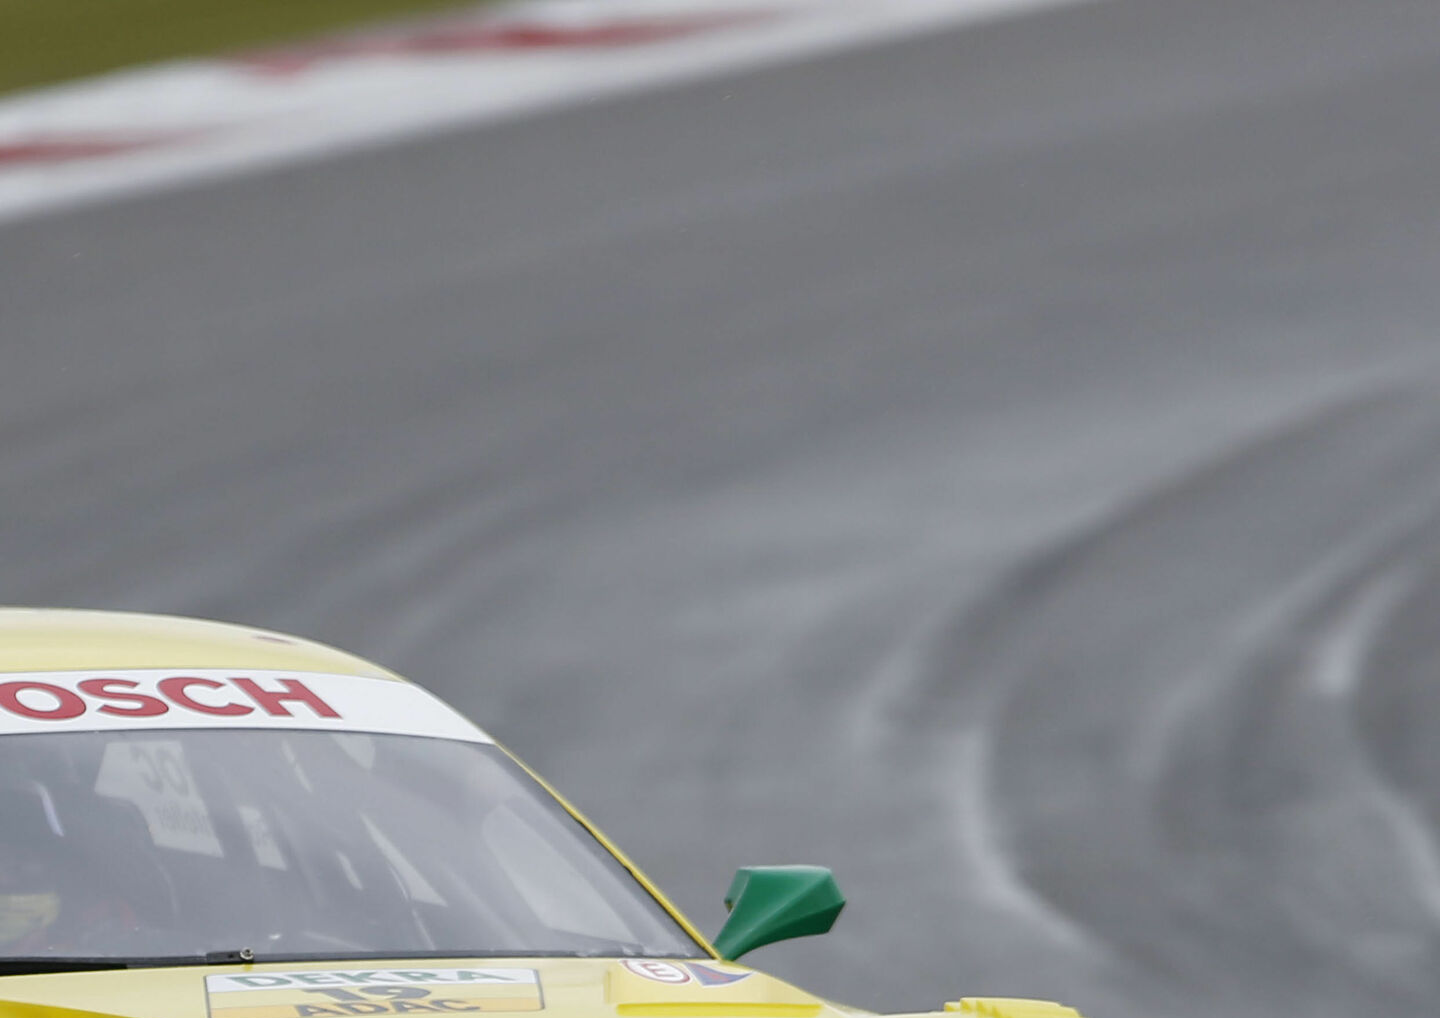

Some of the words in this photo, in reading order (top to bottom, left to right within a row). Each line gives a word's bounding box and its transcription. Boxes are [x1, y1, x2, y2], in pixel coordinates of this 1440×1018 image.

[228, 969, 516, 987] DEKRA
[302, 986, 431, 1001] 19
[295, 999, 480, 1018] ADAC
